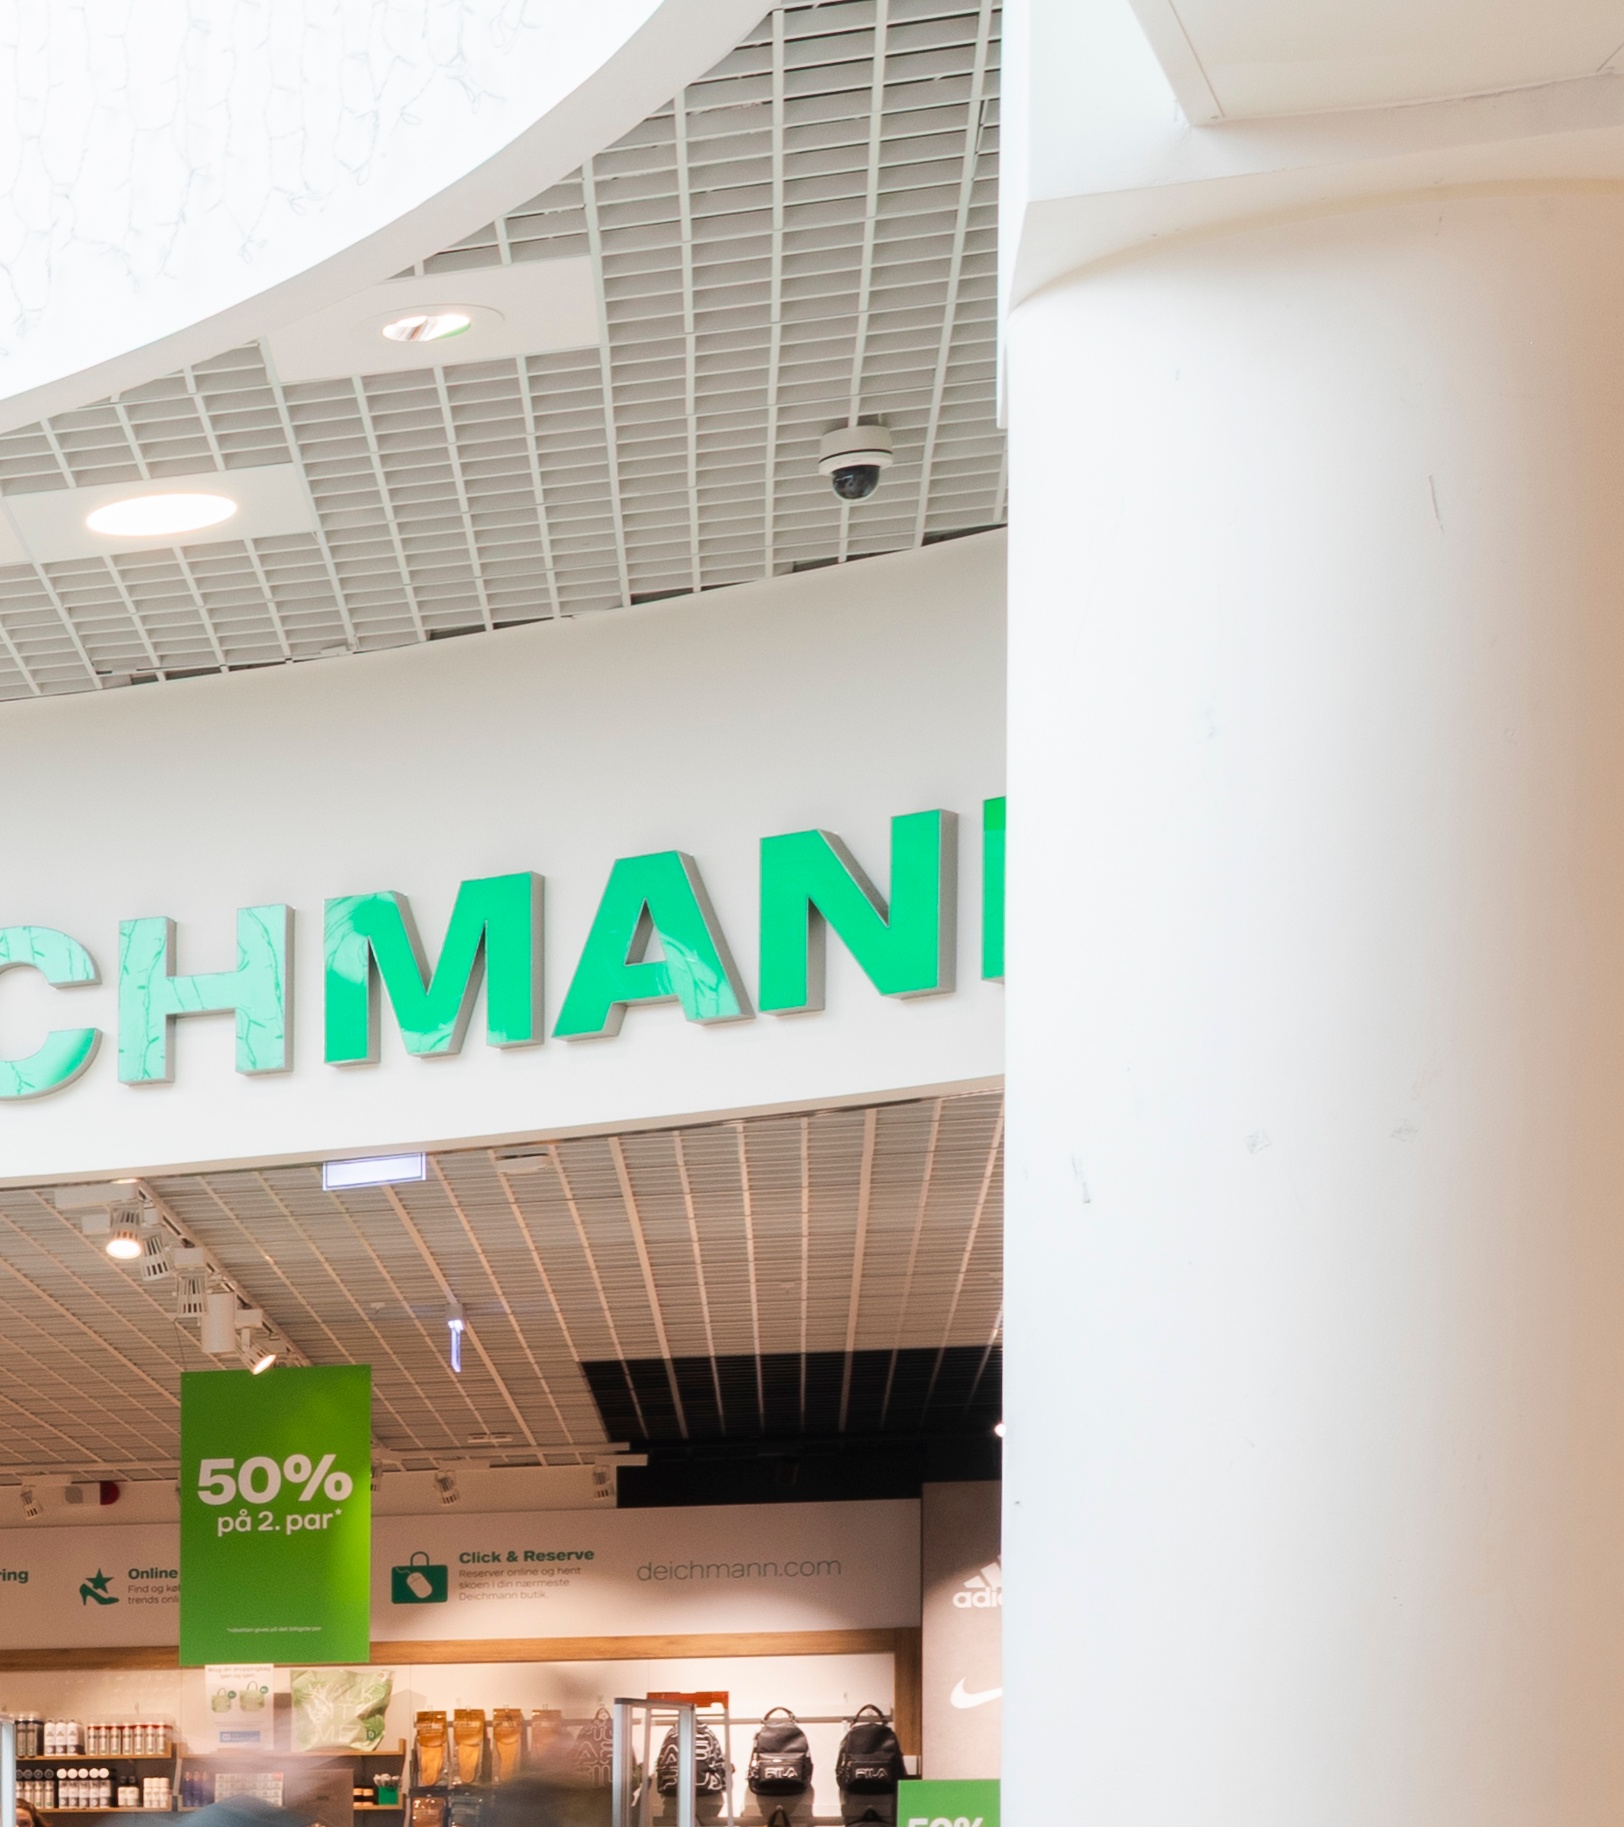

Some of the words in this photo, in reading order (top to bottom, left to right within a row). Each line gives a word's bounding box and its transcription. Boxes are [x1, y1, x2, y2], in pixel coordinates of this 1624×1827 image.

[197, 1454, 353, 1505] 50%
[217, 1509, 252, 1537] på
[258, 1511, 281, 1532] 2.
[459, 1551, 502, 1564] Click
[506, 1551, 518, 1563] &
[523, 1550, 595, 1562] Reserve
[128, 1567, 178, 1580] Online
[459, 1569, 504, 1578] Reserver
[507, 1568, 538, 1577] online
[541, 1568, 554, 1577] og
[557, 1567, 581, 1575] hent
[636, 1560, 842, 1581] deichmann.com
[128, 1585, 149, 1593] Find
[151, 1586, 164, 1595] og
[459, 1592, 518, 1601] Deichmann
[128, 1596, 159, 1604] trends
